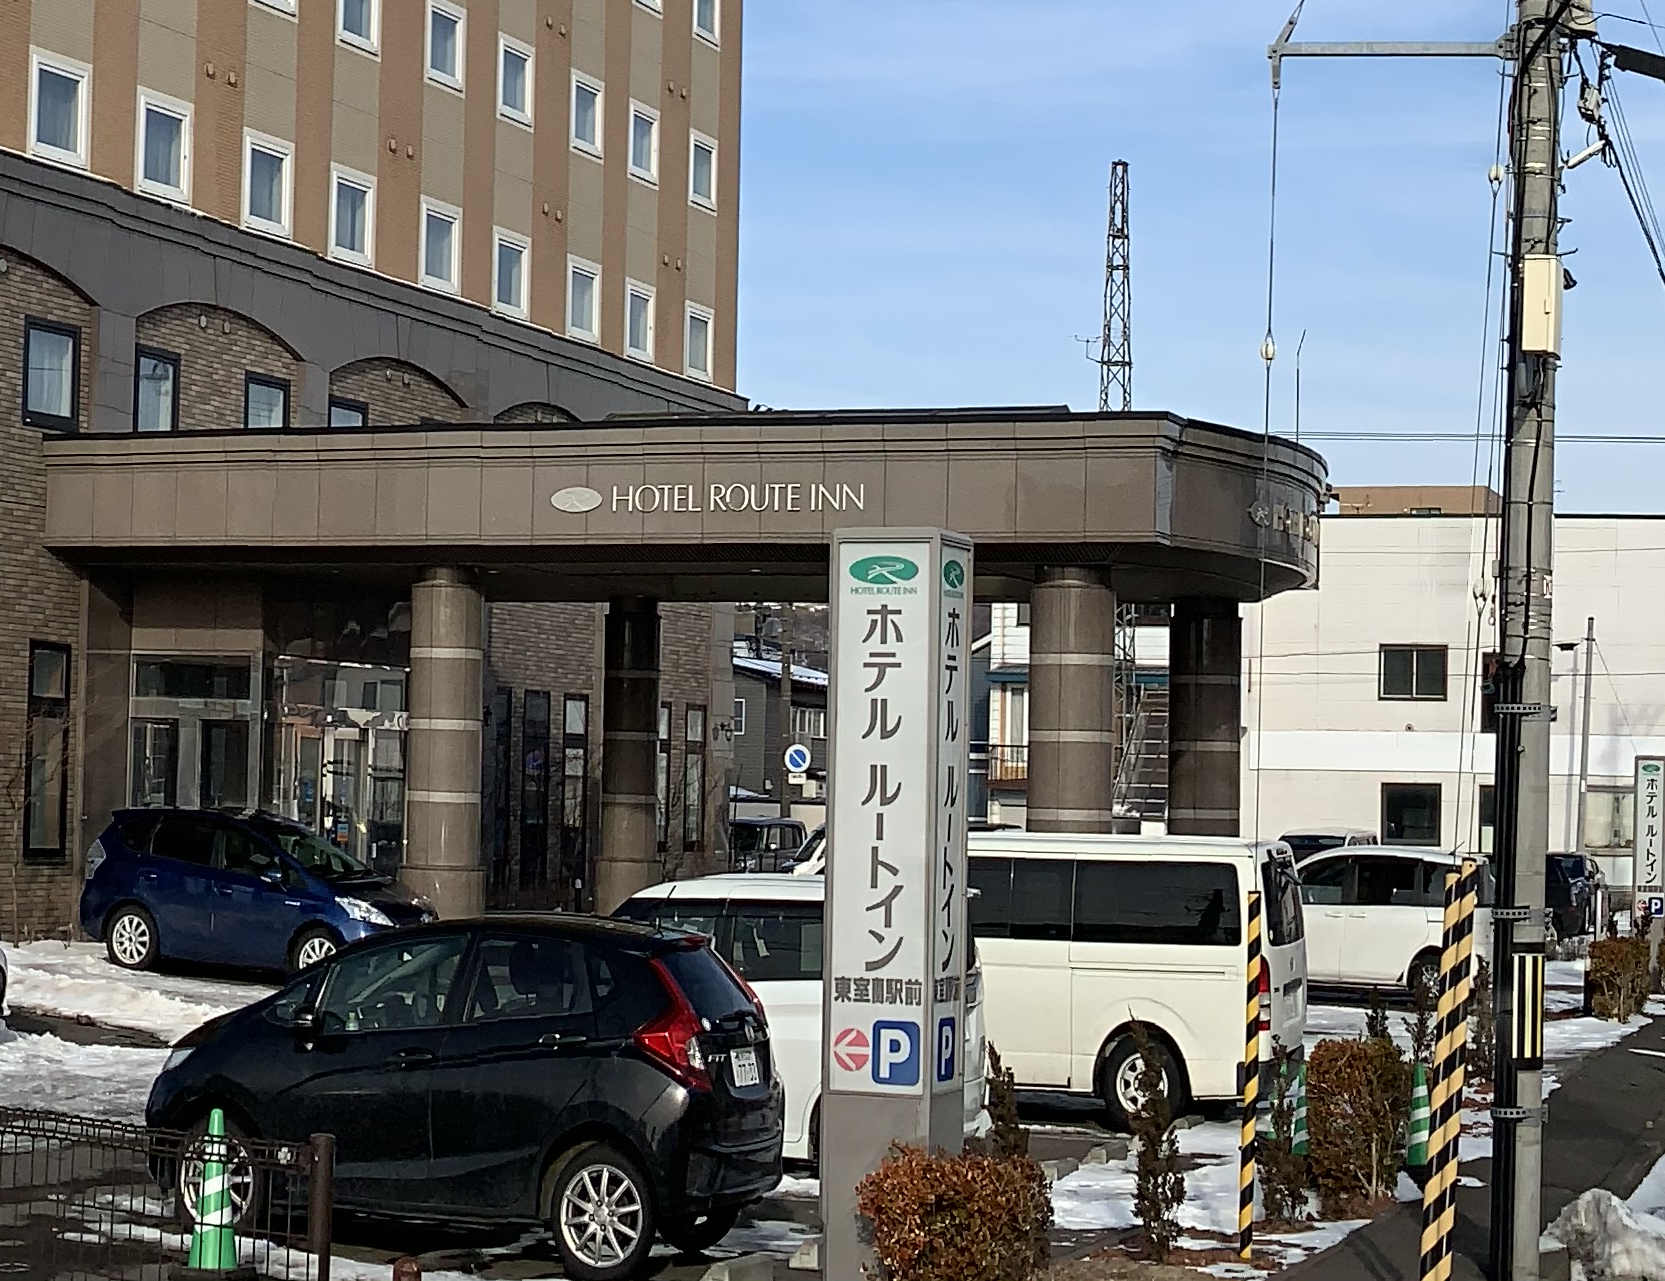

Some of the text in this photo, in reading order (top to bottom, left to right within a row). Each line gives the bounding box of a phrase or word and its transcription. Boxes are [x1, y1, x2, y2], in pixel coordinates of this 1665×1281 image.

[611, 483, 865, 513] HOTEL ROUTE INN
[851, 586, 918, 595] HOTEL ROUTE INN
[944, 607, 960, 743] ホテル
[860, 603, 905, 972] ホテル ルートイン
[1645, 778, 1658, 819] ホテル
[941, 765, 959, 973] ルートイン
[1645, 824, 1658, 885] ルートイン
[1650, 899, 1662, 913] P
[878, 1028, 912, 1079] P
